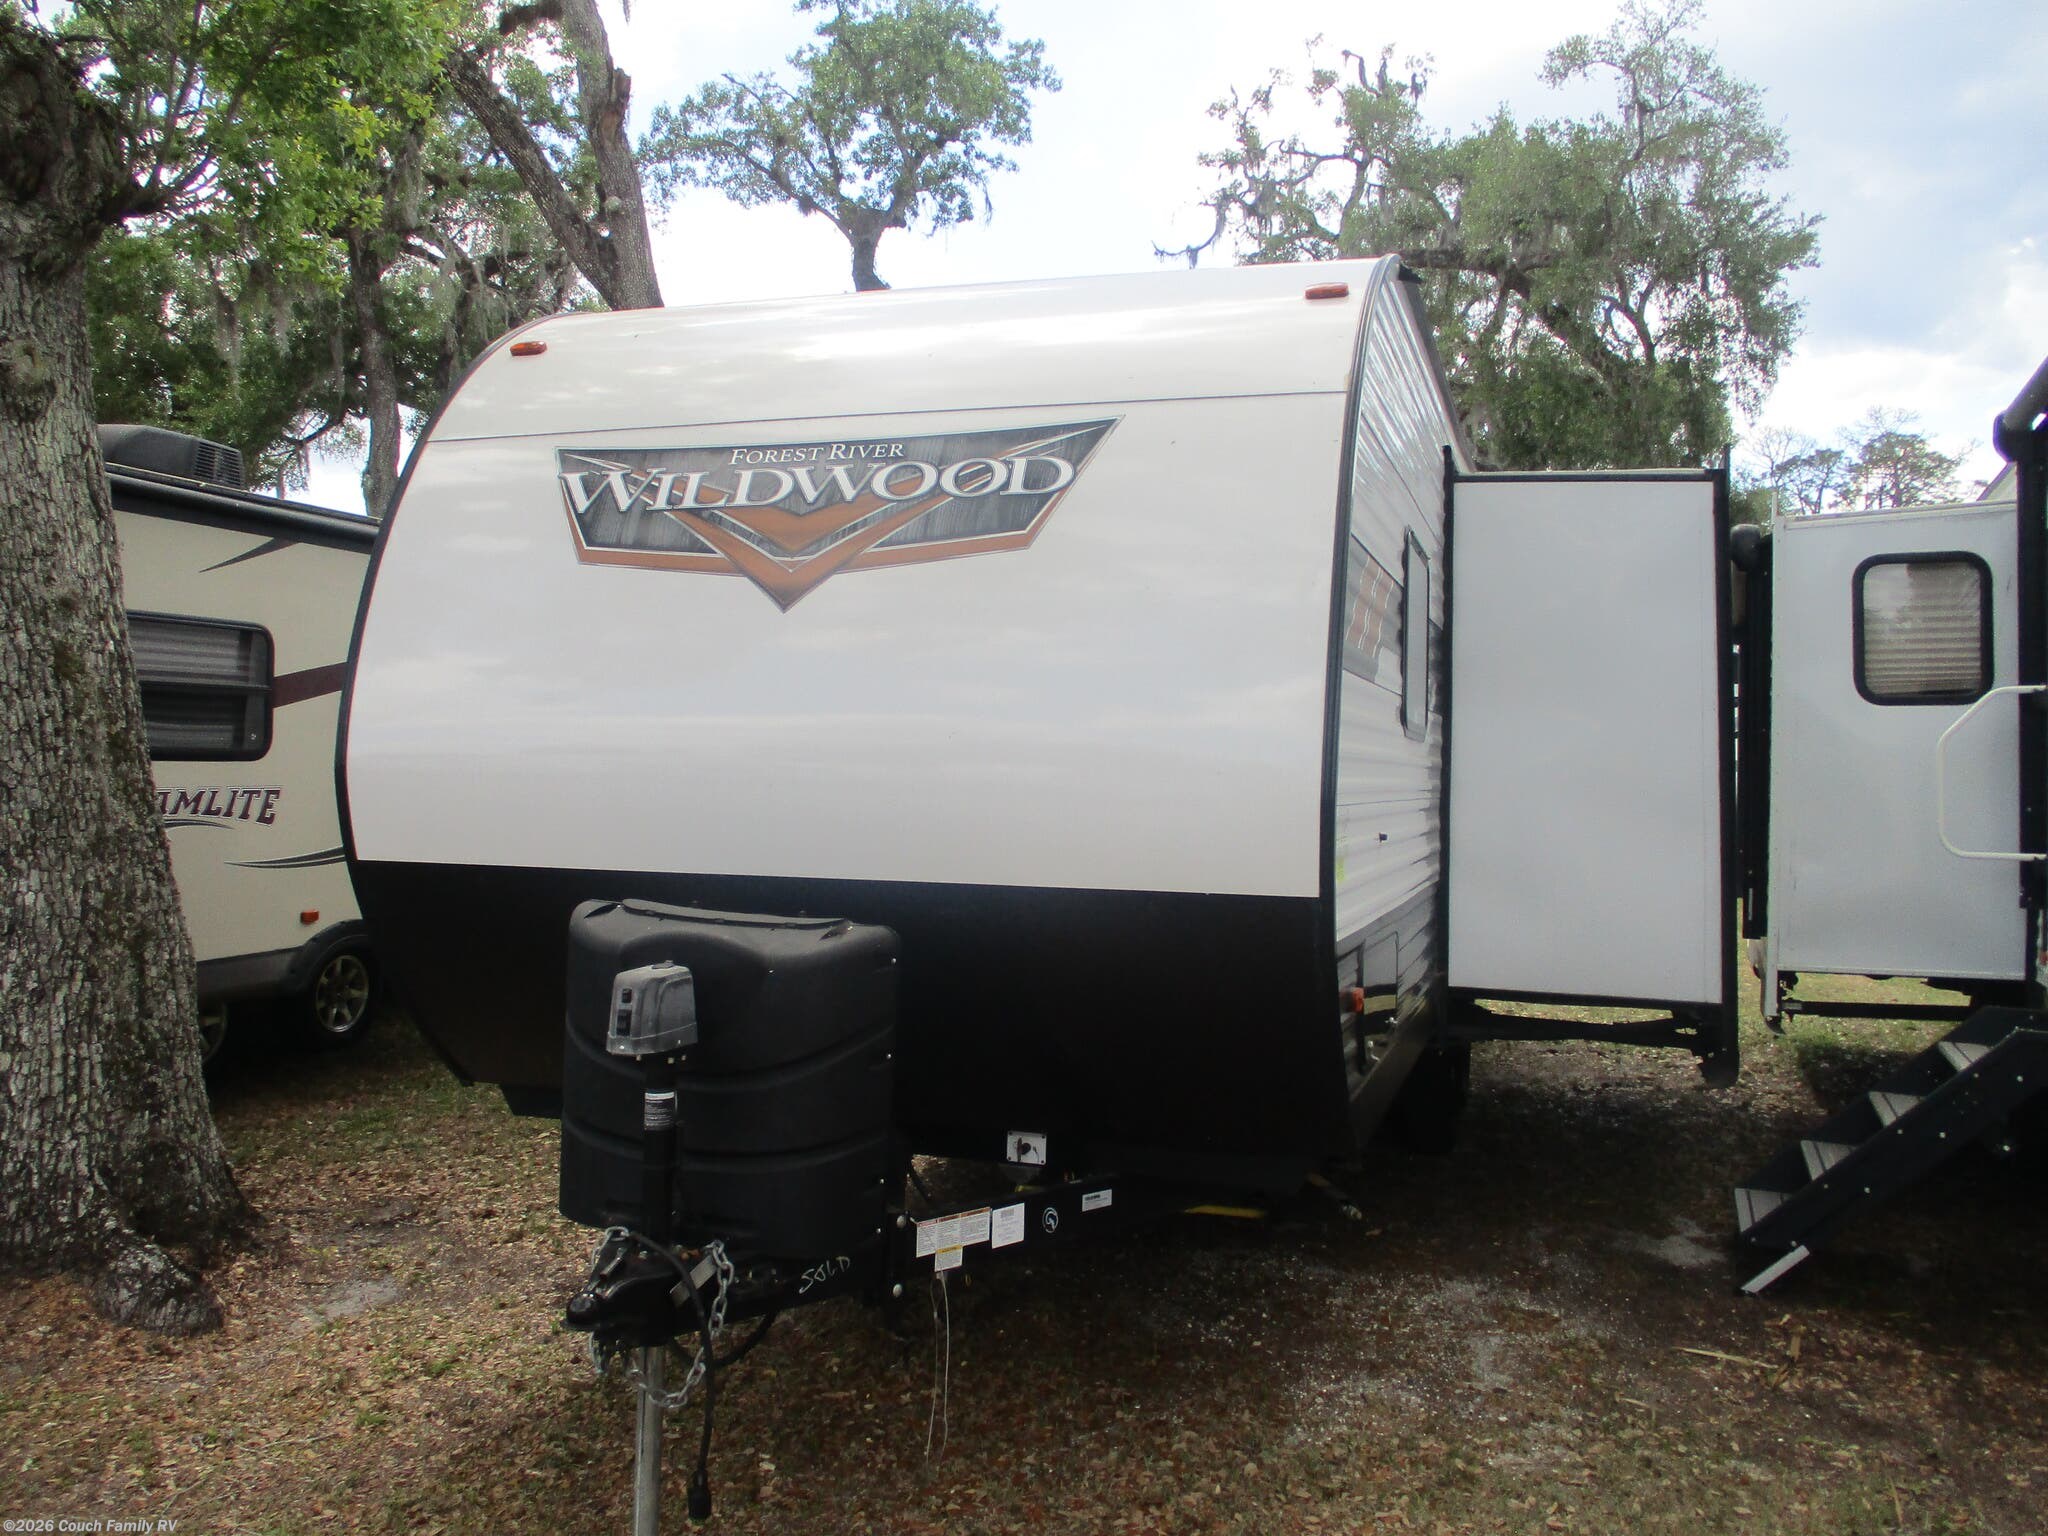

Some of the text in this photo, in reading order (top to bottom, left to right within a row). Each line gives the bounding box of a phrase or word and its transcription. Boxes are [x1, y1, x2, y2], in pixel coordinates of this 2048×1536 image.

[728, 443, 905, 466] FOREST RIVER
[558, 455, 1075, 514] WILDWOOD
[798, 1255, 851, 1294] SOLD
